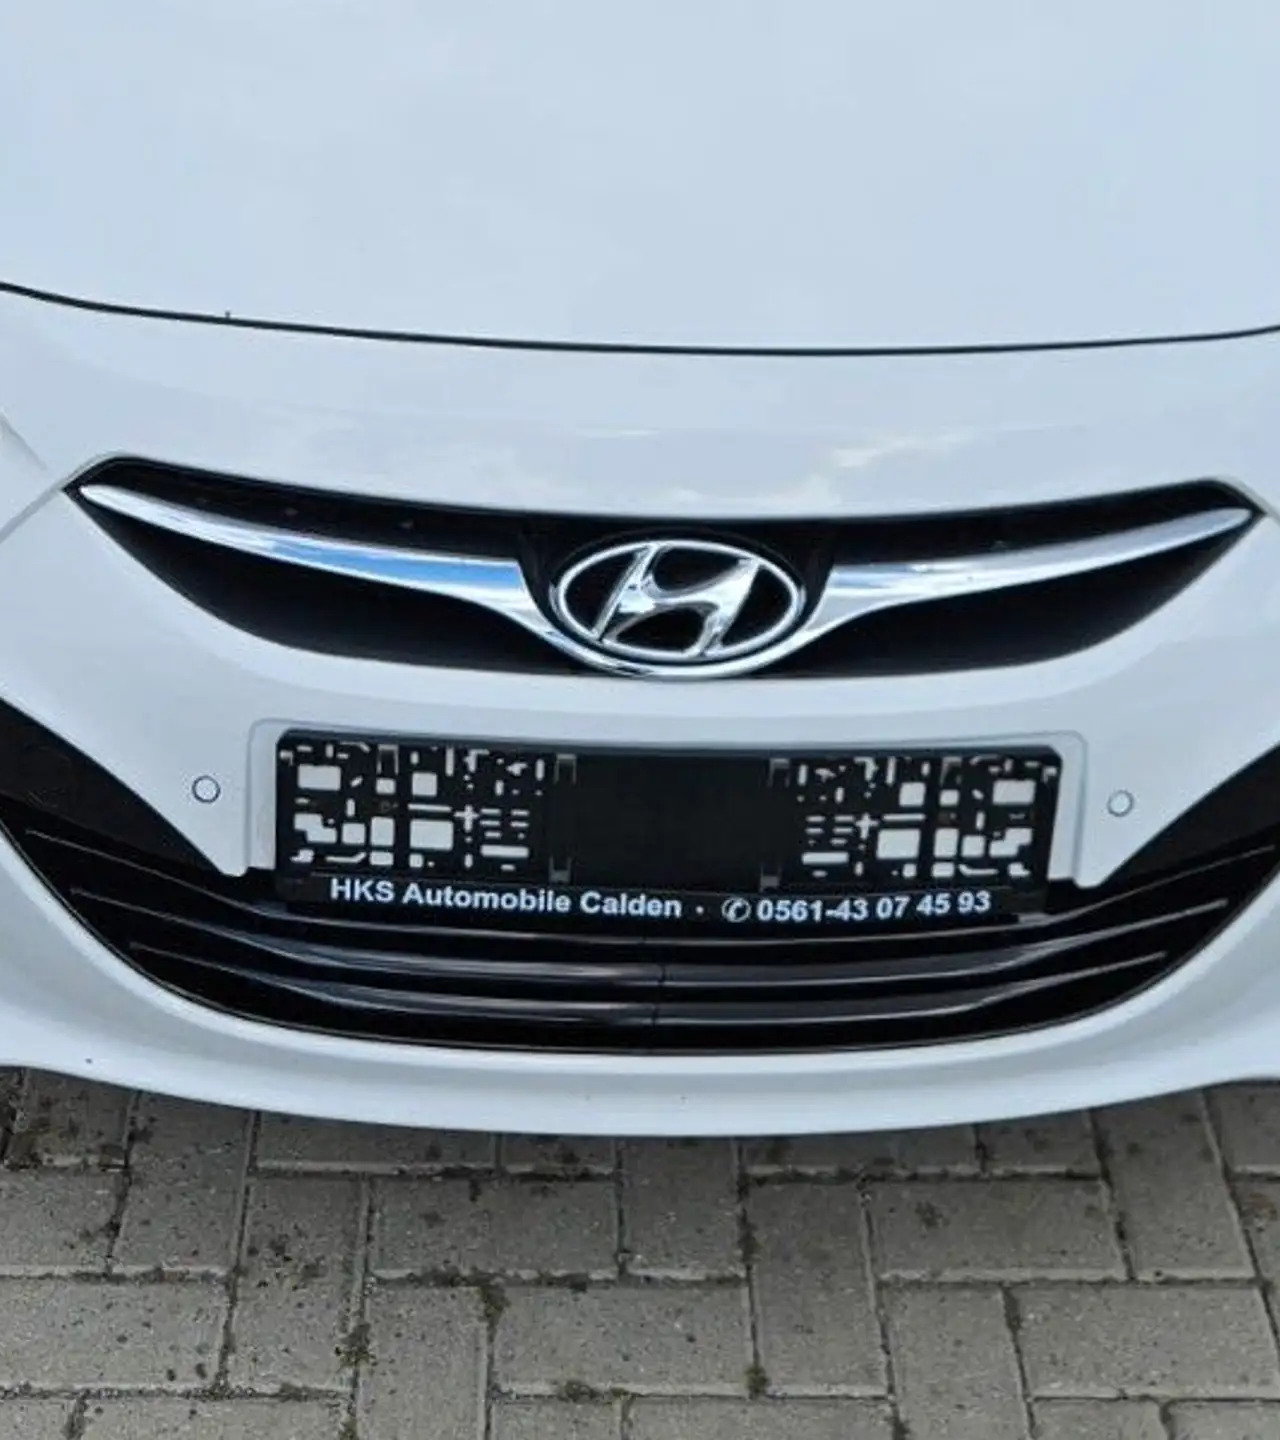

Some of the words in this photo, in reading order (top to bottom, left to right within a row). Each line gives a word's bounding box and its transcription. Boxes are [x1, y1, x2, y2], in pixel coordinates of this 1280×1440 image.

[330, 877, 395, 903] HKS
[402, 882, 571, 912] Automobile
[580, 890, 682, 918] Calden
[757, 898, 869, 921] 0561-43
[876, 895, 910, 920] 07
[917, 892, 951, 915] 45
[958, 889, 991, 913] 93
